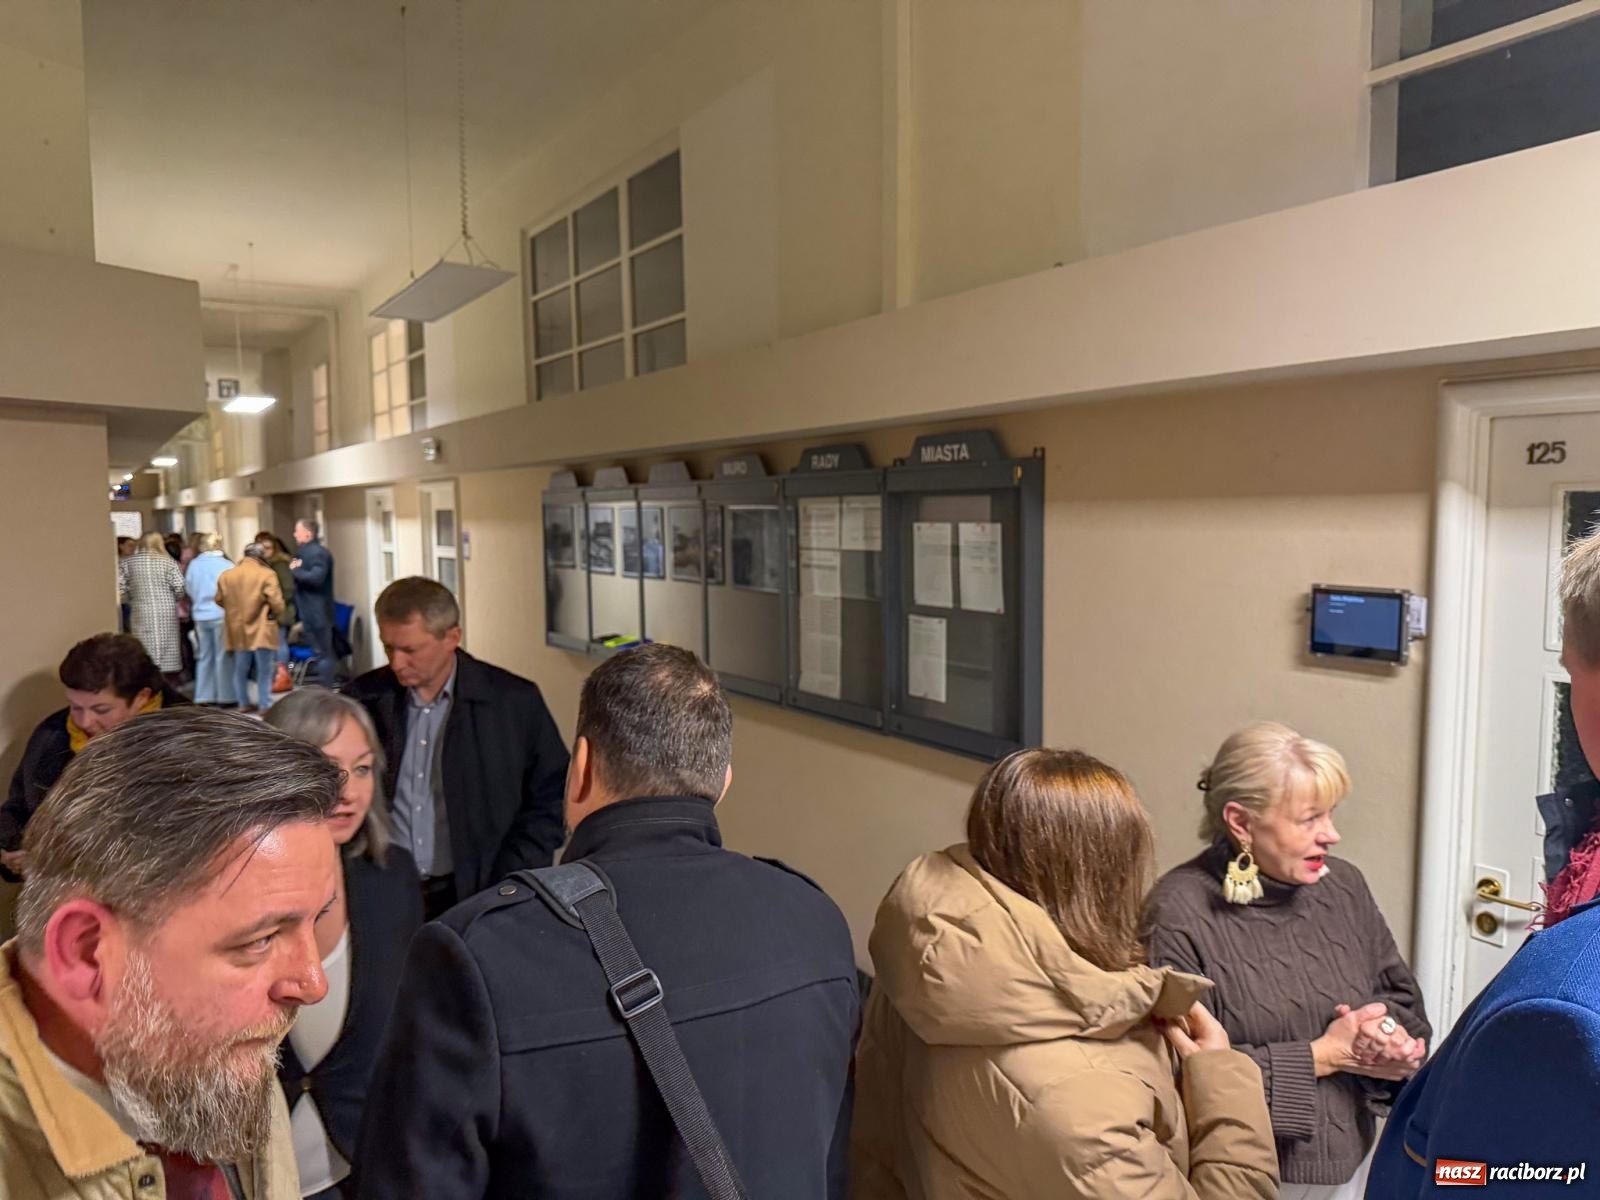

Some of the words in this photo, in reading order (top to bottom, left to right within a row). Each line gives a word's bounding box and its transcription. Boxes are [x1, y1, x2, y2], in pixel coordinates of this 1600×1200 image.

[811, 453, 840, 470] RADY
[920, 443, 970, 464] MIASTA
[1526, 441, 1567, 465] 125
